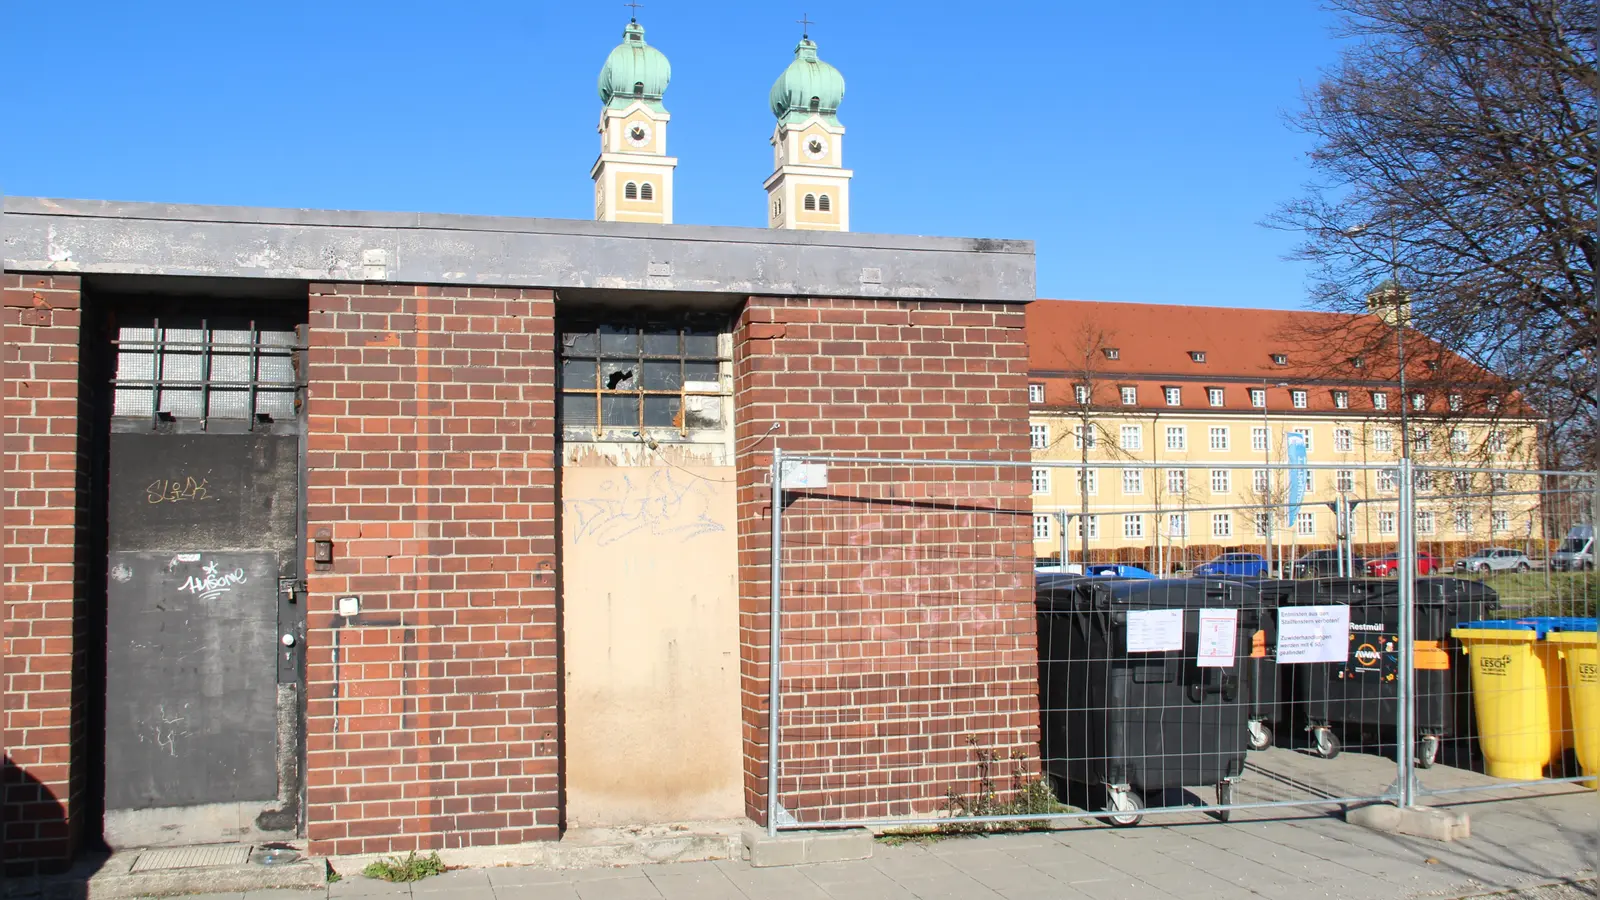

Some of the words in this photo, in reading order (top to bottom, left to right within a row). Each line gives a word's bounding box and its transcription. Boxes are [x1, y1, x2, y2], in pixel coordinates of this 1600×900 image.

[1350, 622, 1384, 631] Restmüll
[1355, 651, 1381, 659] AWM
[1480, 660, 1506, 668] LESCH
